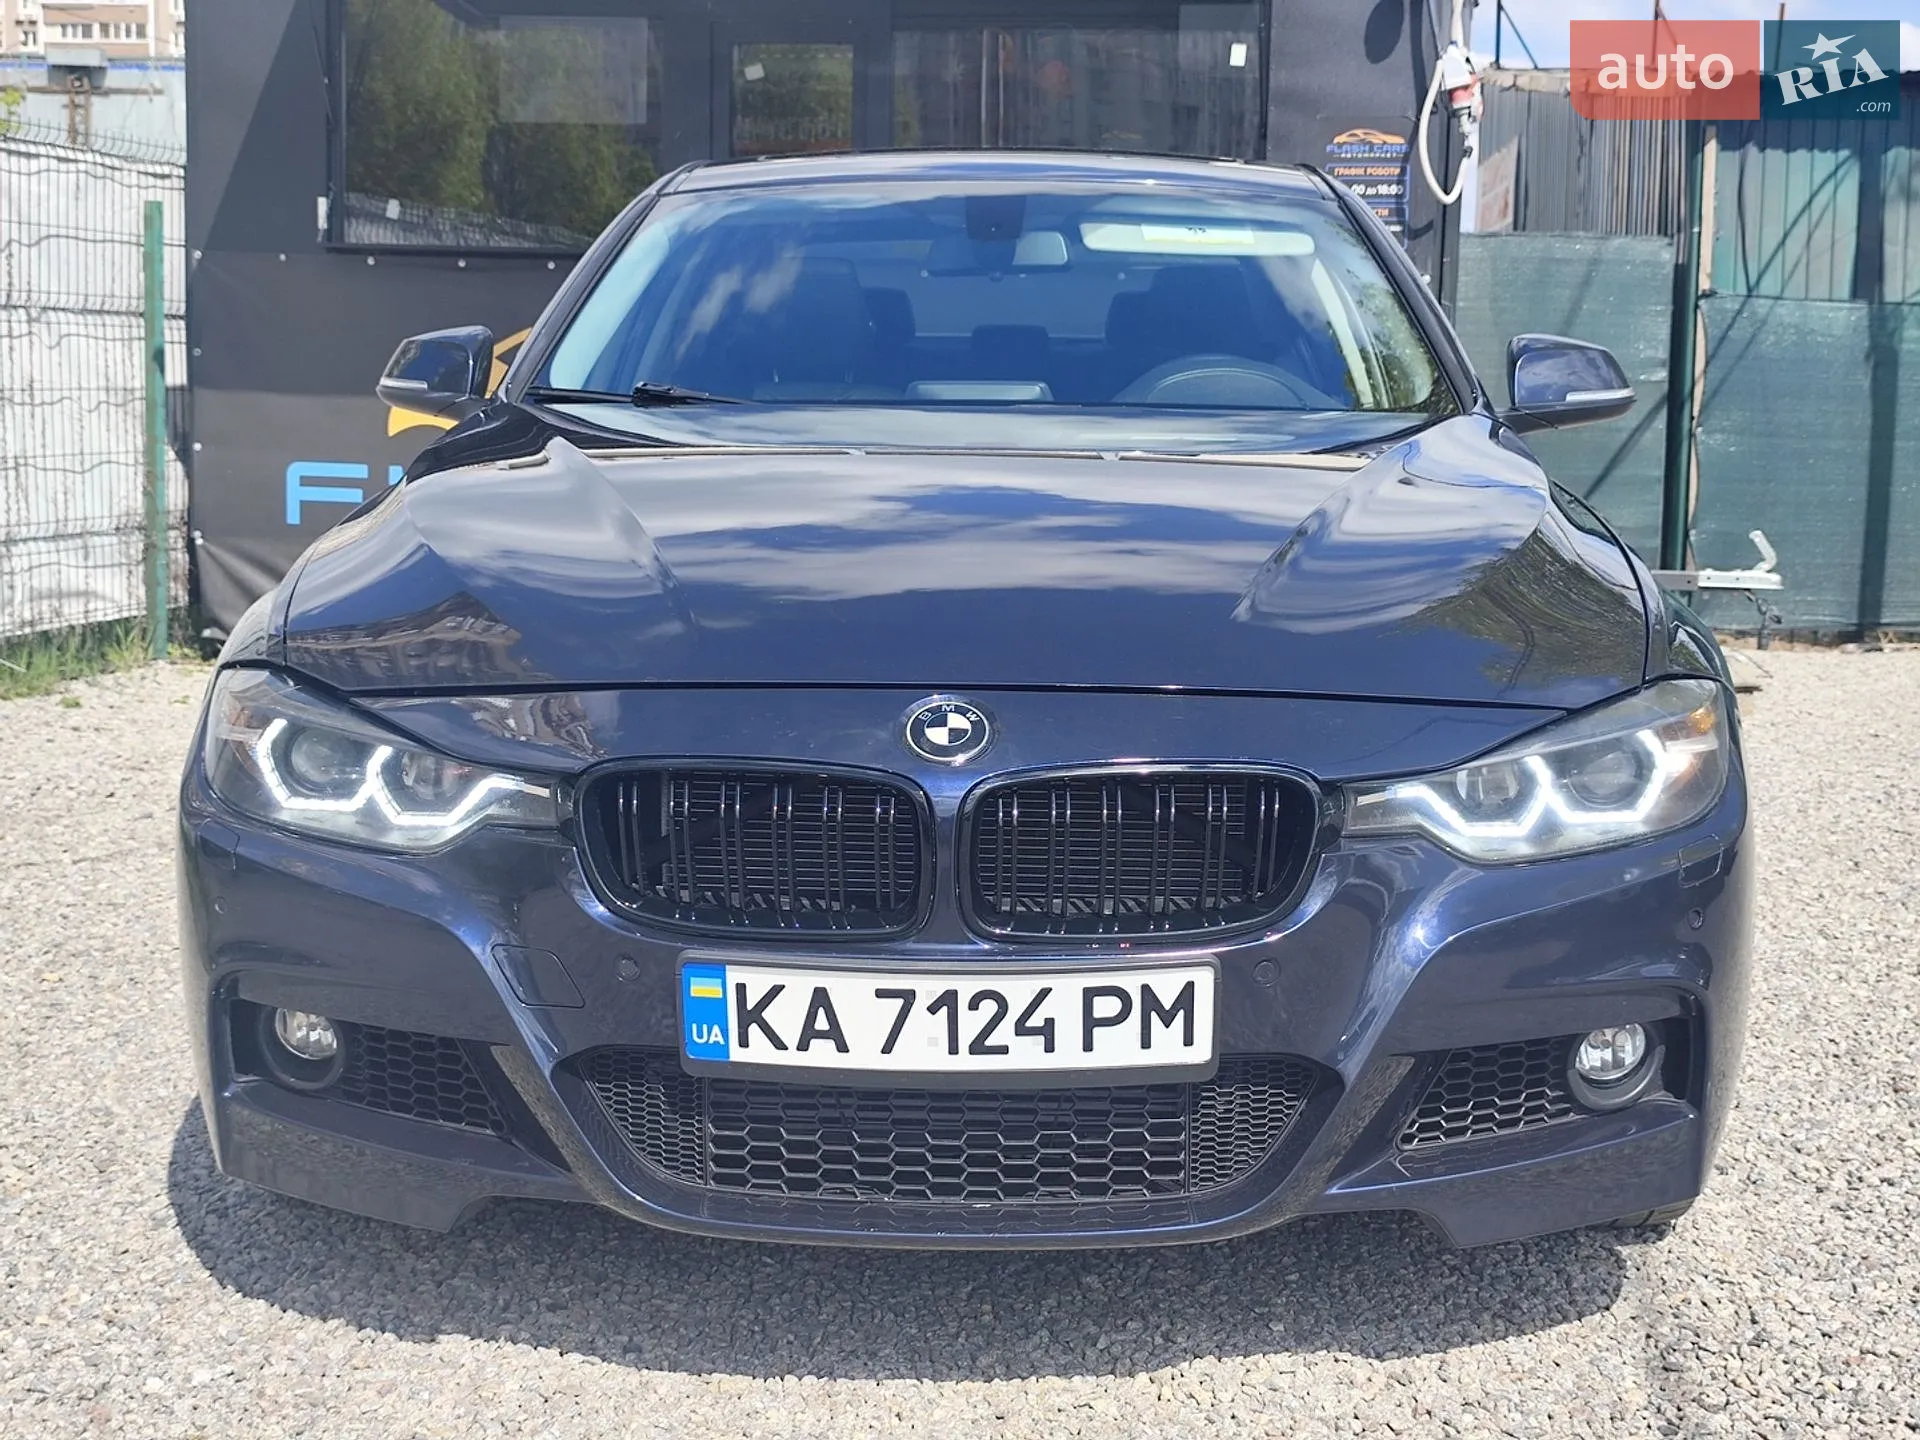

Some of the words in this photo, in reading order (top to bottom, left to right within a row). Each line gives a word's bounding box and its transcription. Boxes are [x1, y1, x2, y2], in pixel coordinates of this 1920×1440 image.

[1326, 144, 1369, 153] FLASH
[1377, 184, 1404, 195] 18:00
[917, 705, 981, 721] BMW
[736, 982, 850, 1053] KA
[875, 987, 1055, 1056] 7124
[1081, 980, 1195, 1053] PM
[692, 1023, 725, 1045] UA
